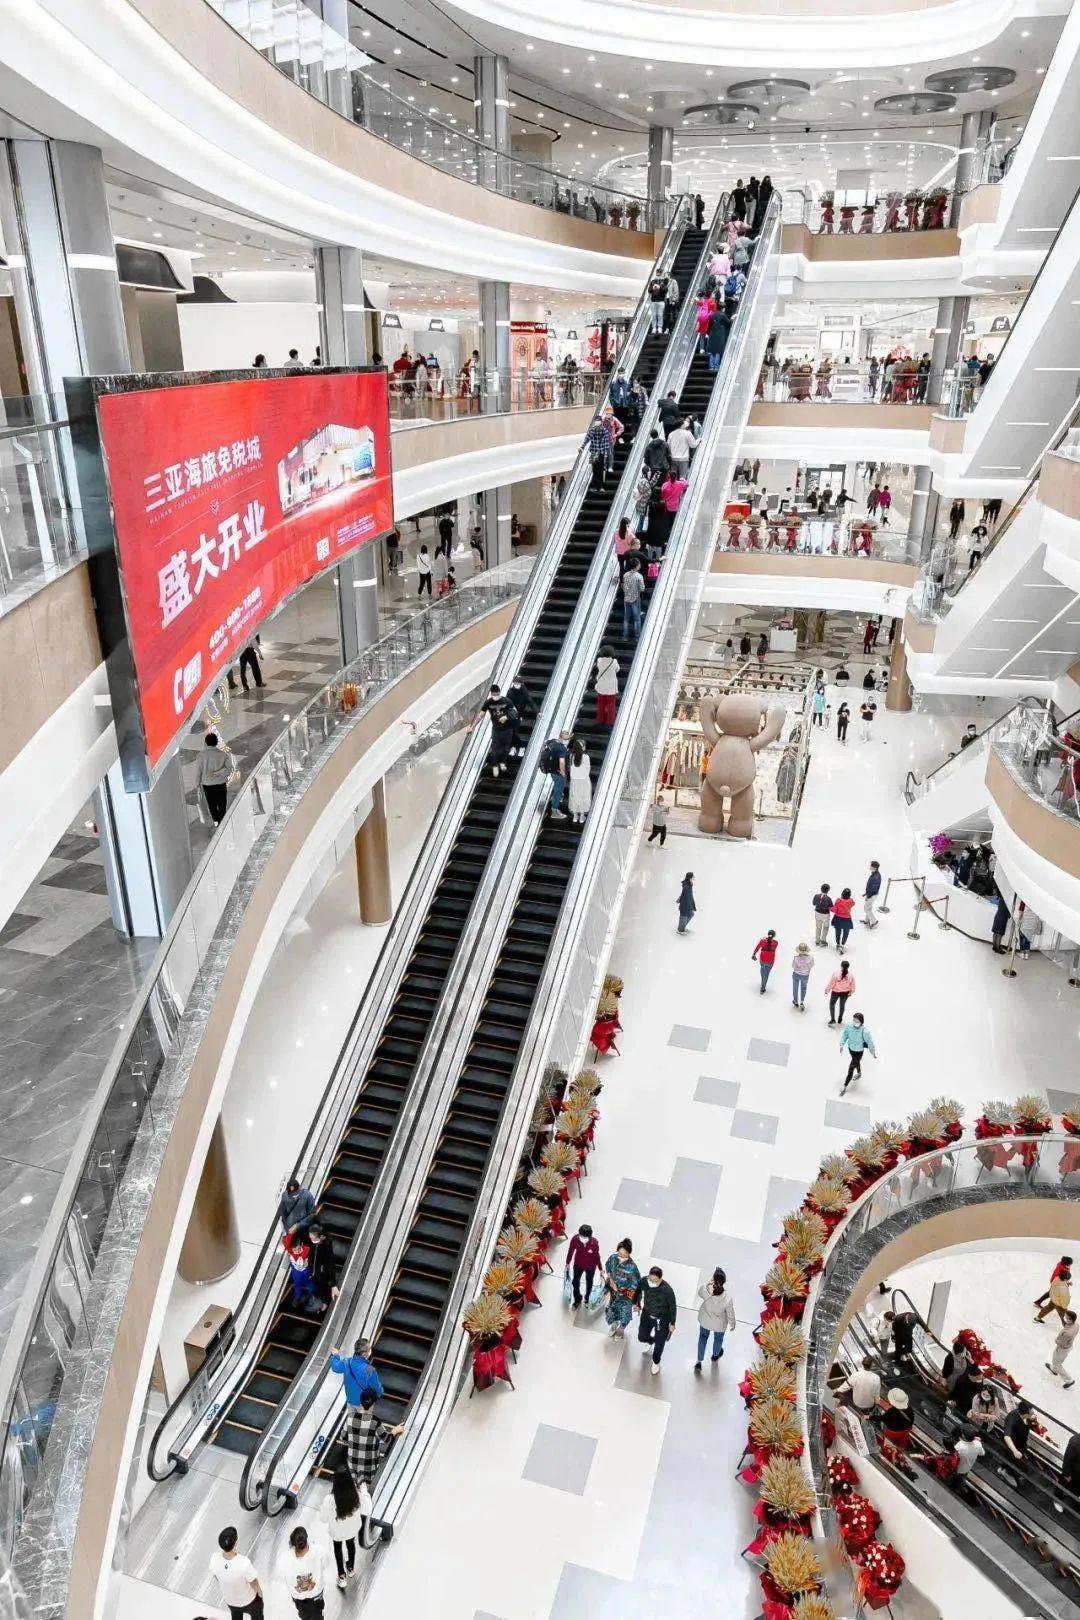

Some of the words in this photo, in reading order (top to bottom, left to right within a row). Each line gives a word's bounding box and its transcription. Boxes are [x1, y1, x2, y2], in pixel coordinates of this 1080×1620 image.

[144, 435, 262, 512] 三亚海旅免税城
[158, 499, 267, 629] 盛大开业
